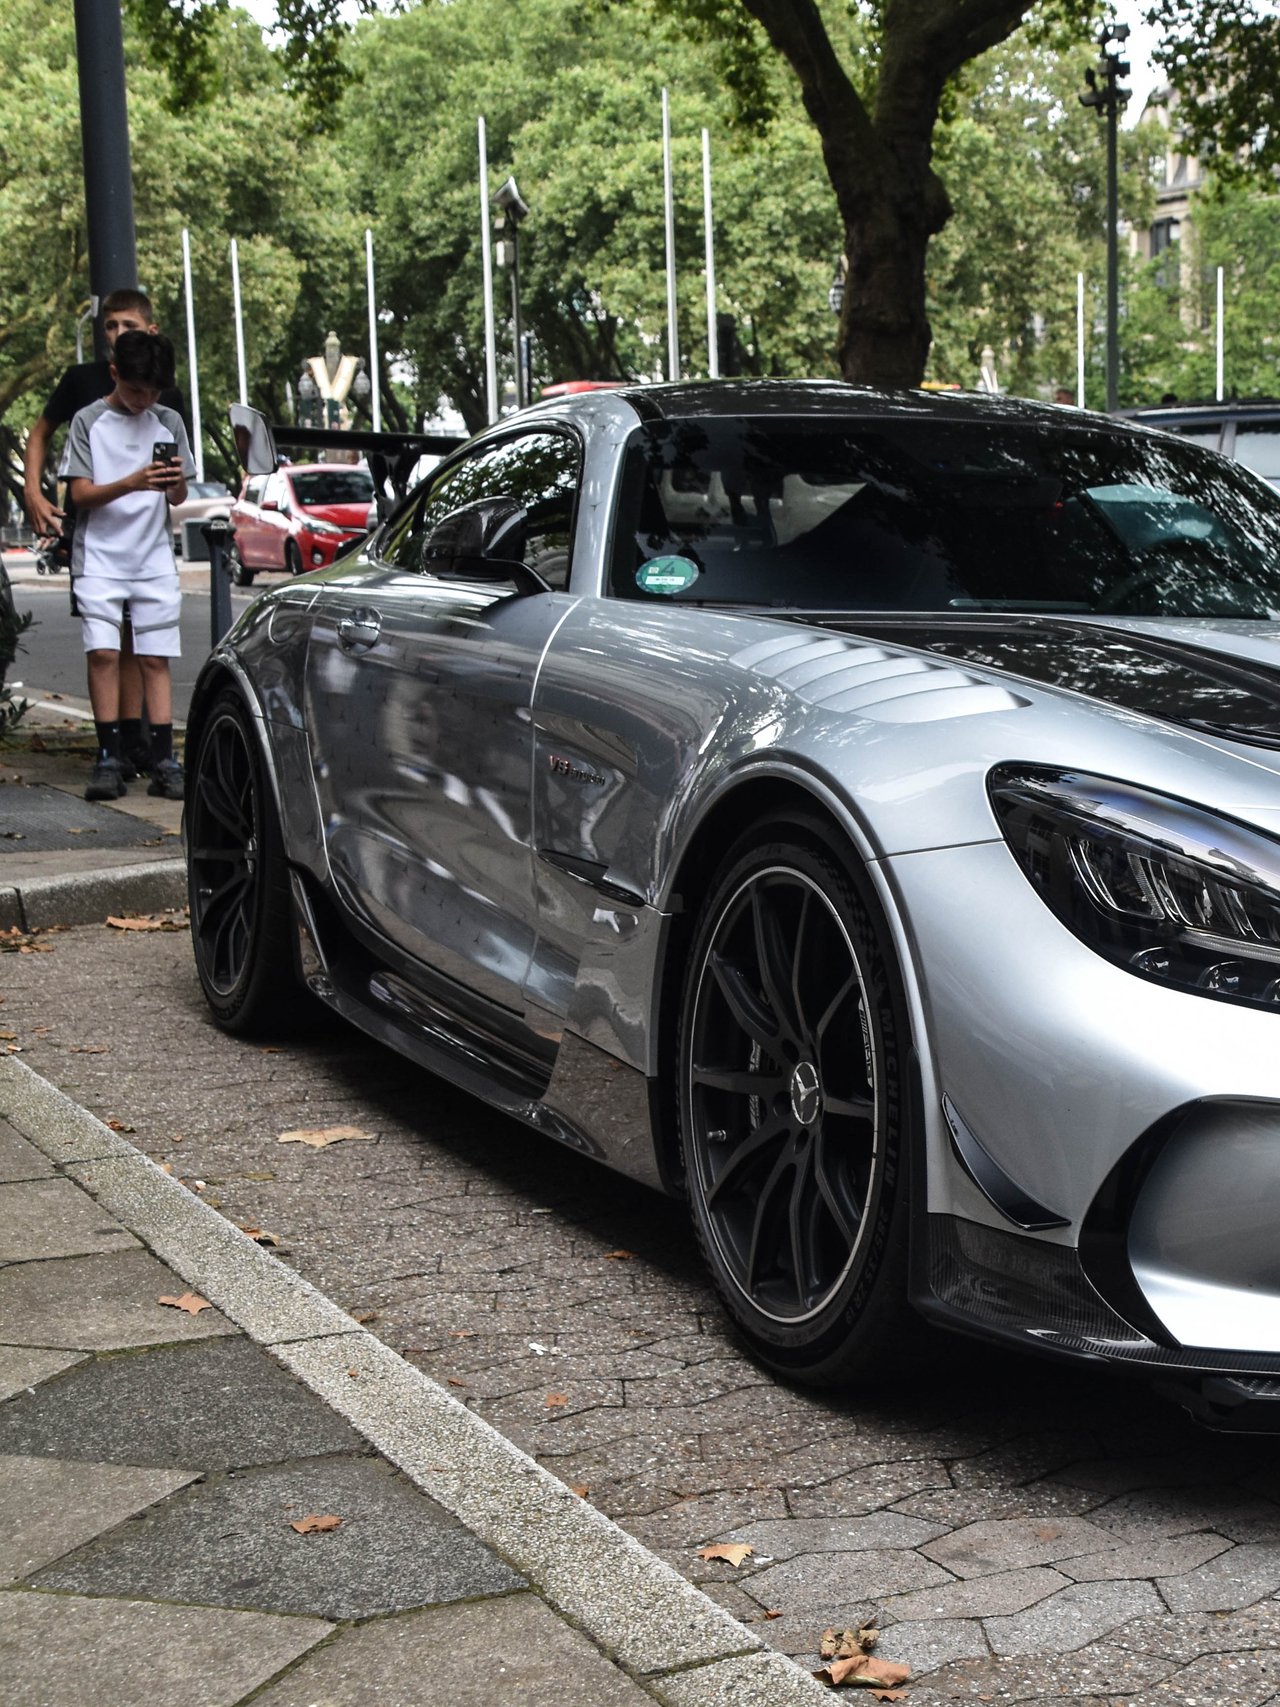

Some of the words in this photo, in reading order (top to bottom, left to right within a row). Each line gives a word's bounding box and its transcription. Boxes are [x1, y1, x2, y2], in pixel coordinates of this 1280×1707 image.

[661, 561, 675, 576] 4
[549, 755, 570, 775] V8
[879, 1007, 901, 1188] MICHELIN
